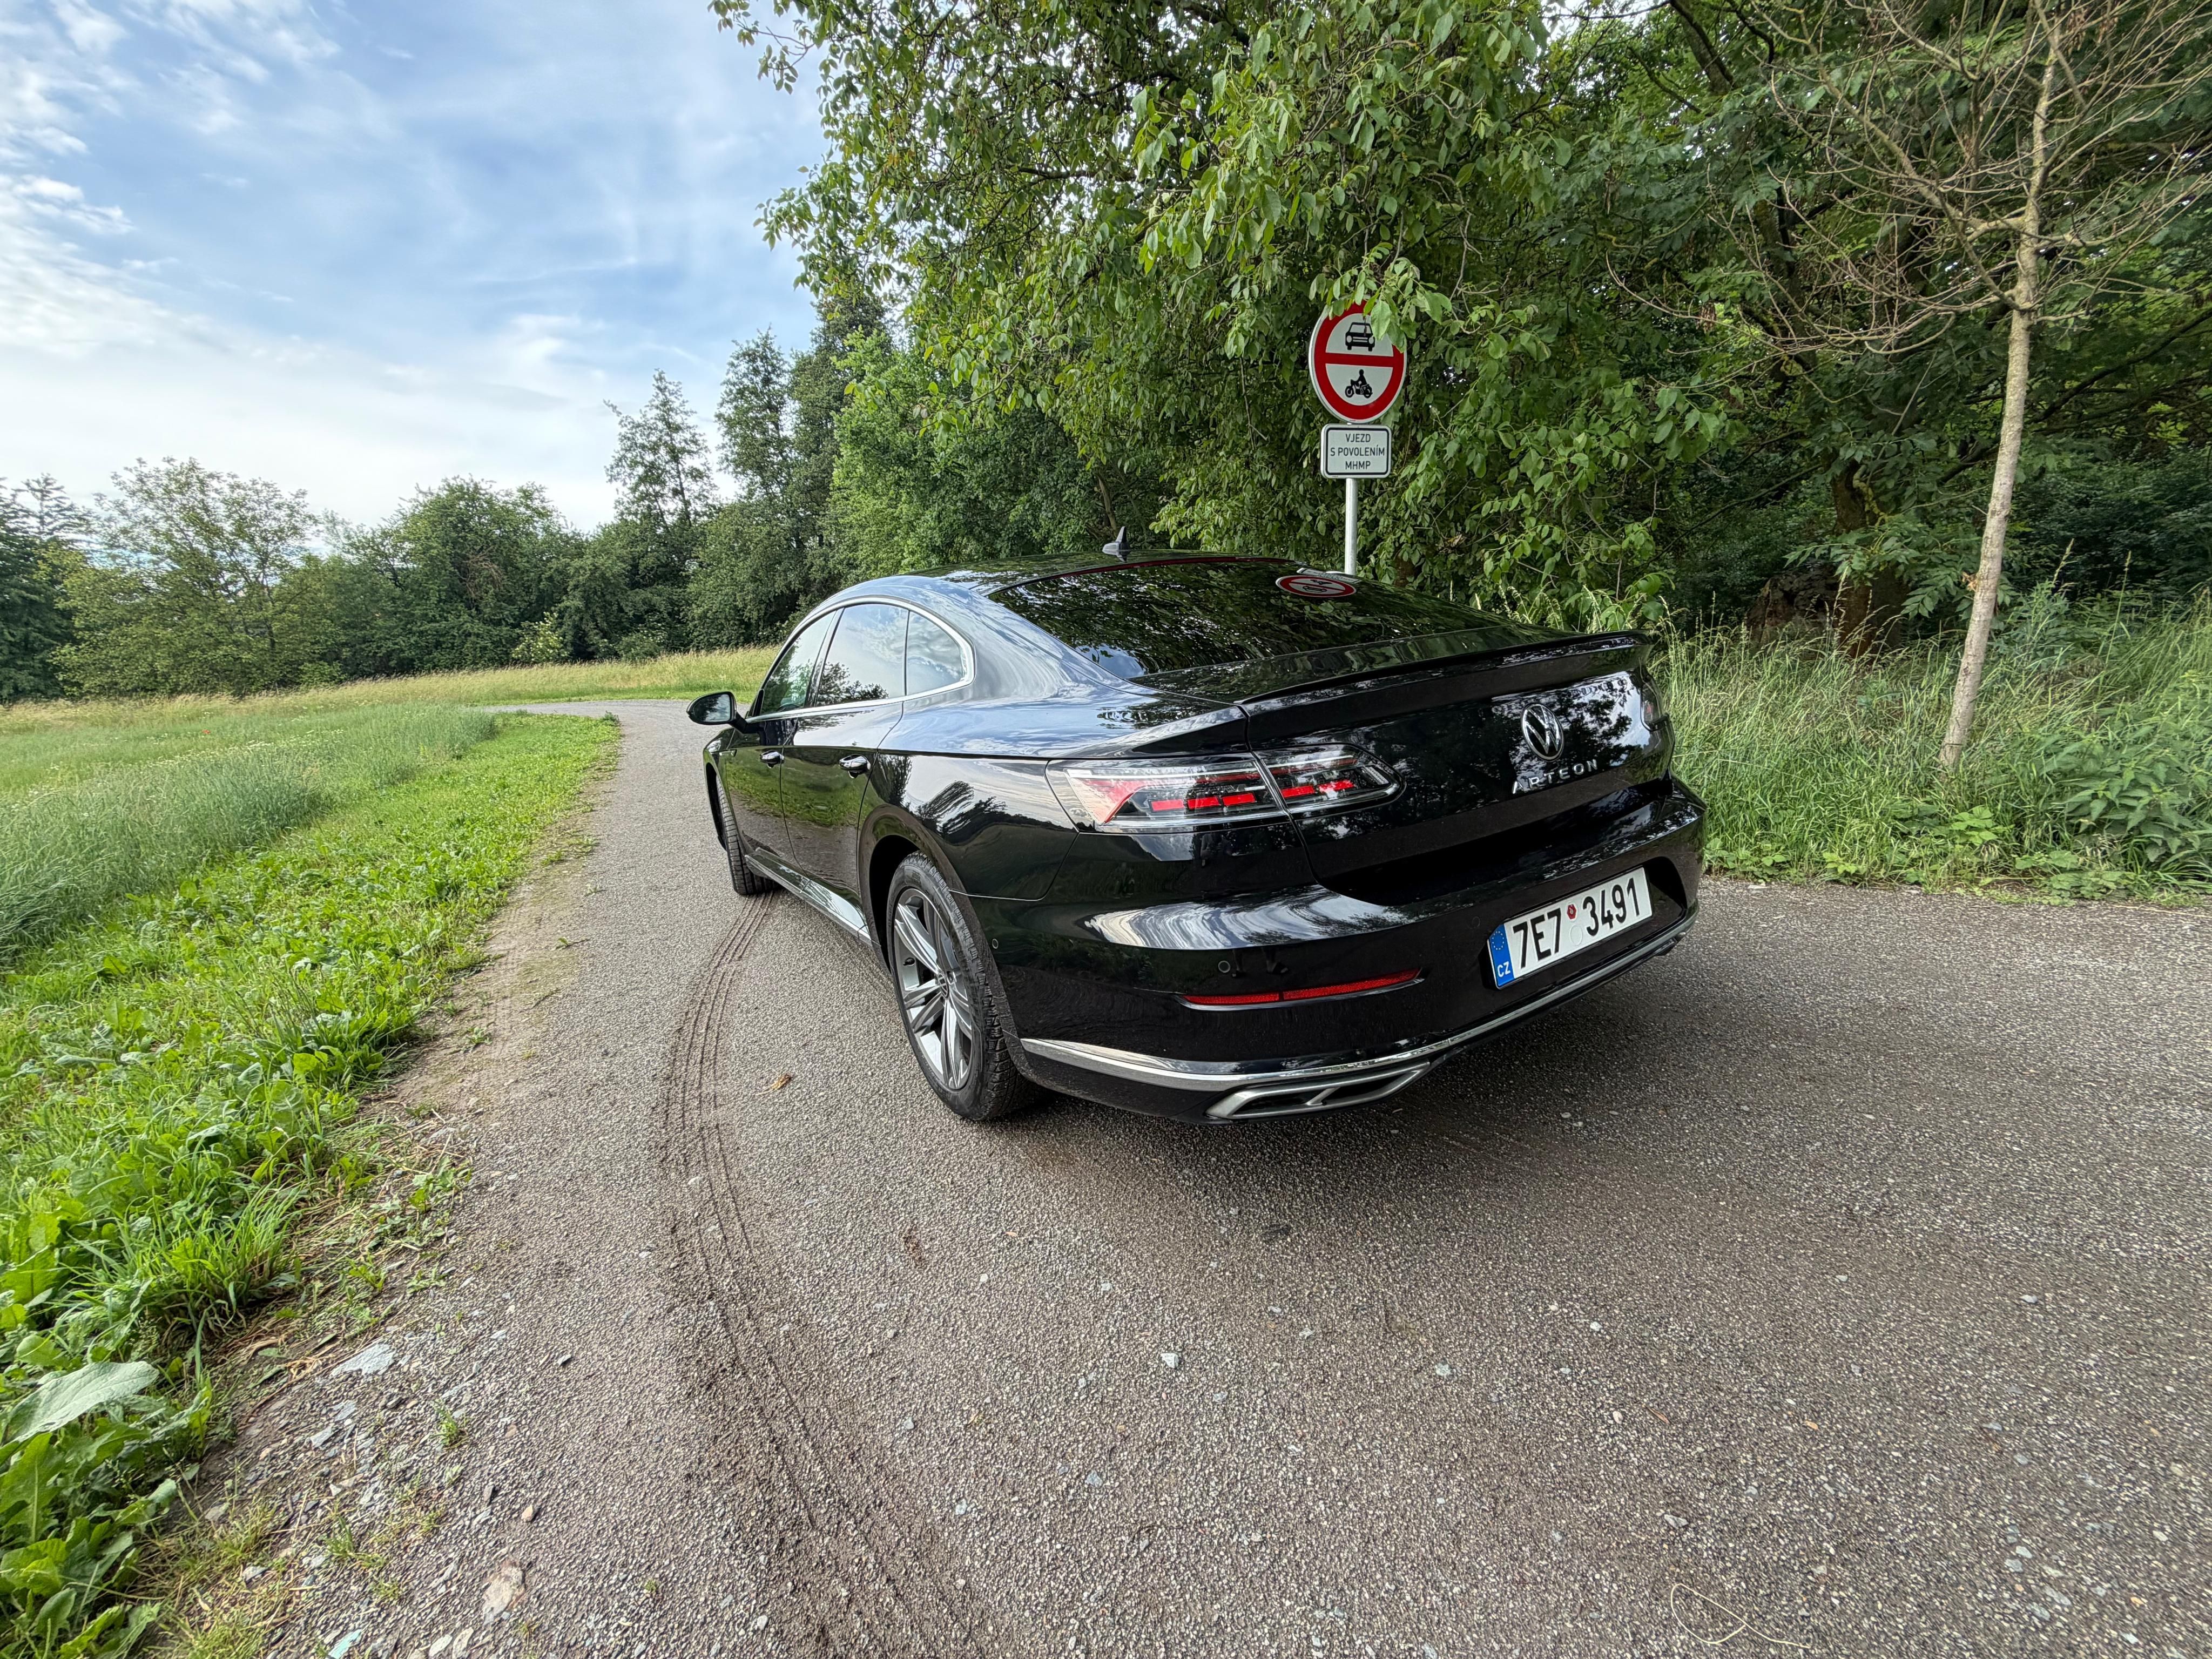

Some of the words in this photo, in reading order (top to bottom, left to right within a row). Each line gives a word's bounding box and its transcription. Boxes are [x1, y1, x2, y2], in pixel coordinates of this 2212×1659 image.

[1345, 434, 1371, 442] VJEZD
[1330, 448, 1335, 456] S
[1338, 444, 1385, 456] POVOLENÍM
[1345, 461, 1371, 469] MHMP
[1513, 759, 1598, 794] ARTEON
[1513, 908, 1561, 969] 7E7
[1582, 878, 1640, 937] 3491
[1496, 961, 1510, 977] CZ
